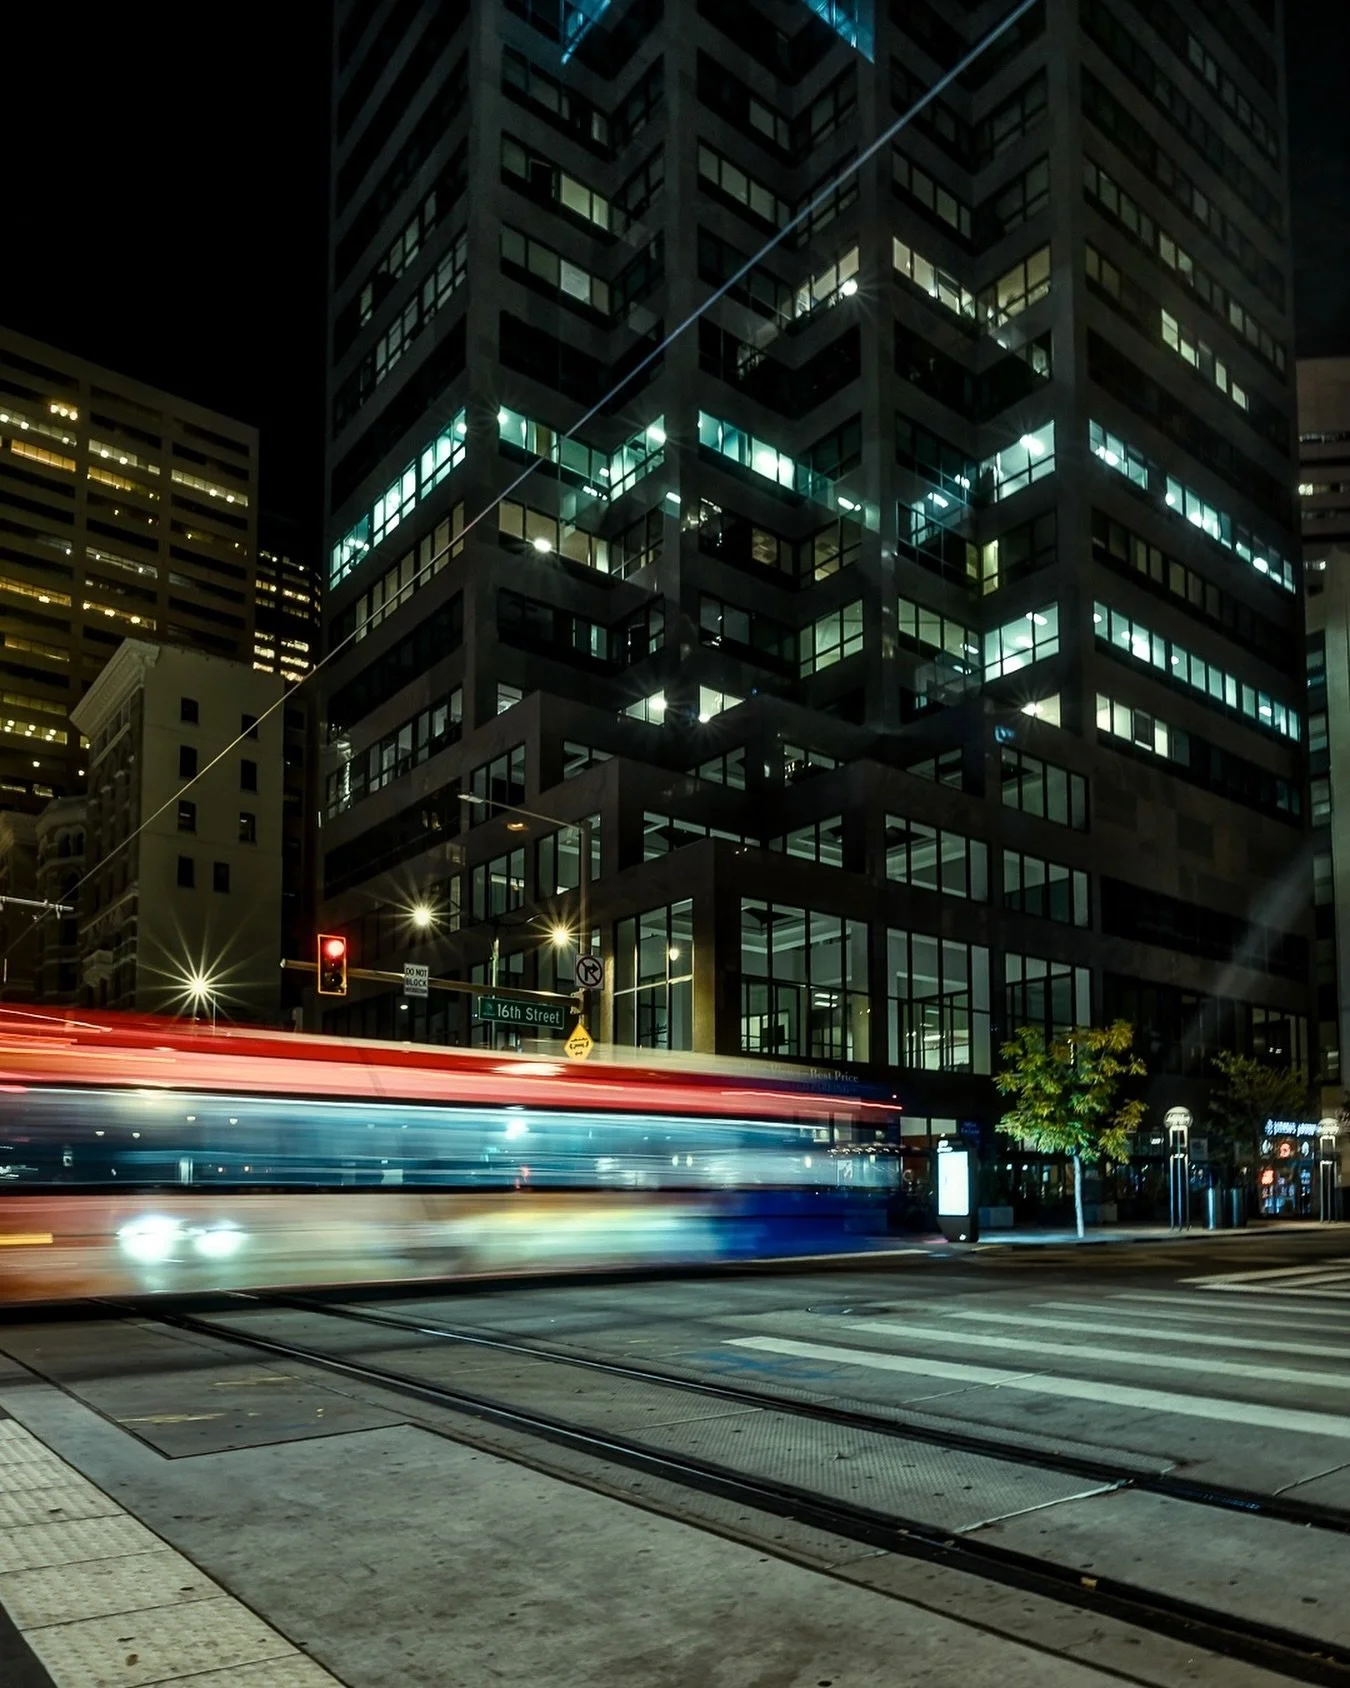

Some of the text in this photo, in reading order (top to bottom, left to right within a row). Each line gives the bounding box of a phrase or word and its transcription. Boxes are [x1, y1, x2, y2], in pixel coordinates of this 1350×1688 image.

[405, 967, 427, 977] DO NOT
[405, 978, 427, 987] BLOCK
[498, 1003, 560, 1024] 16th Street
[834, 1071, 859, 1082] Price
